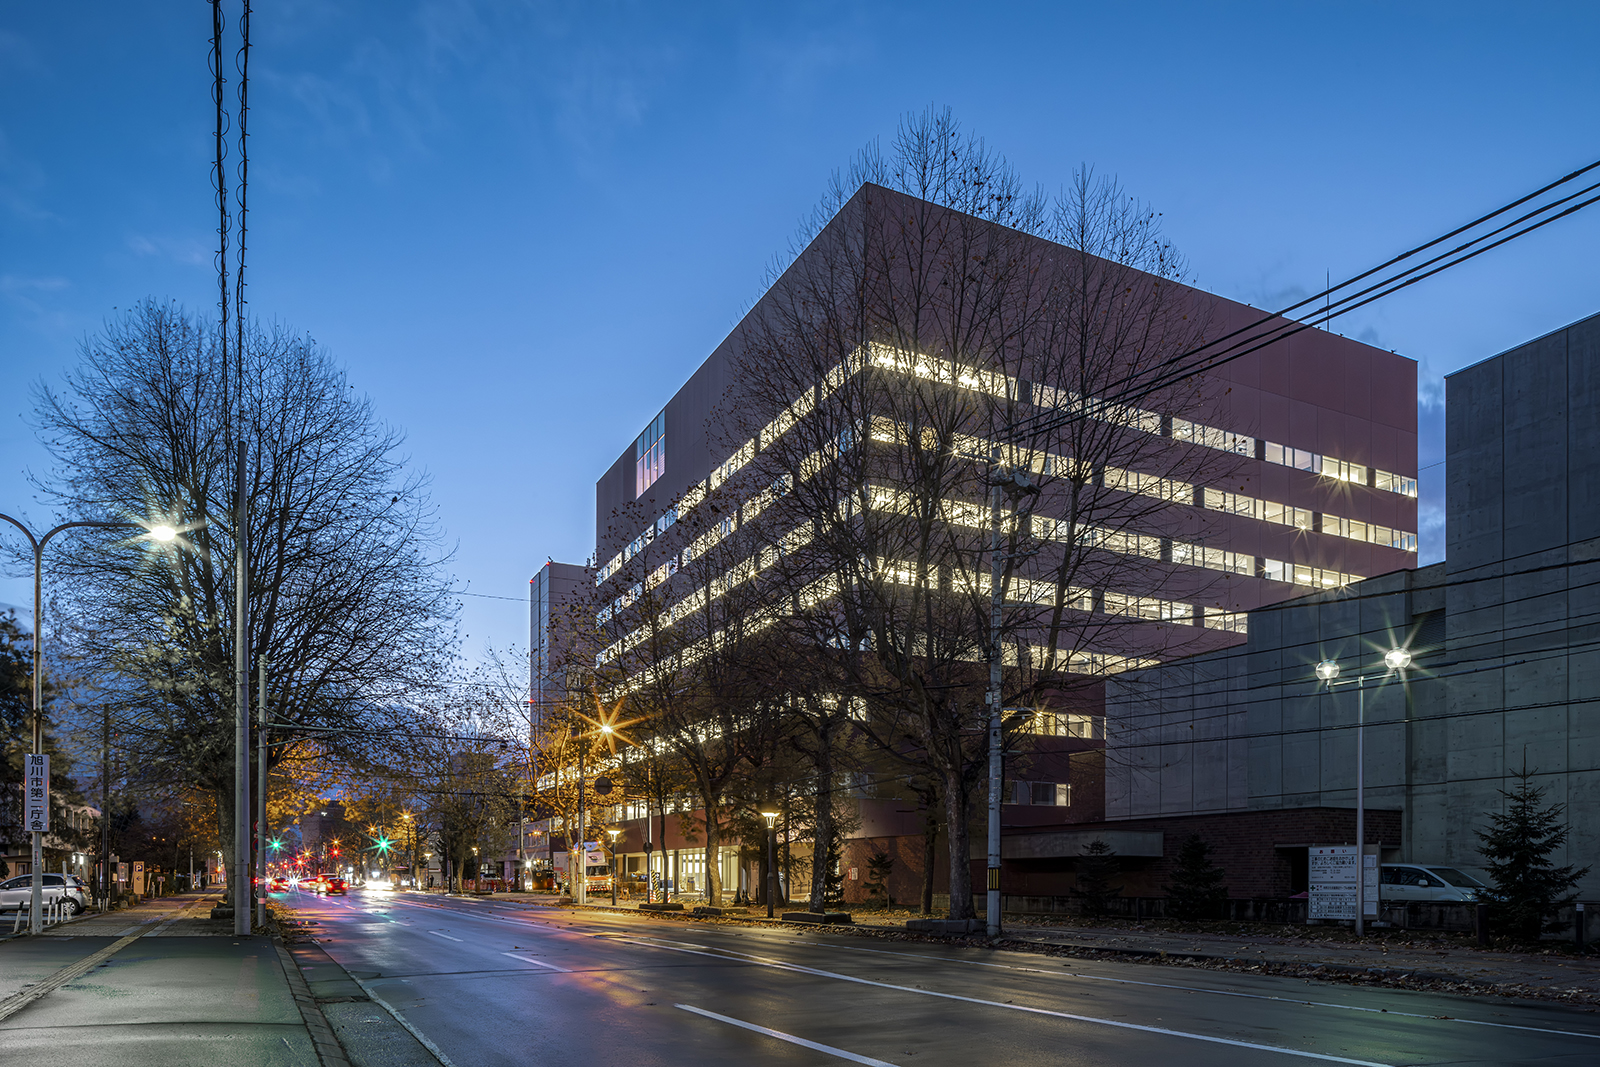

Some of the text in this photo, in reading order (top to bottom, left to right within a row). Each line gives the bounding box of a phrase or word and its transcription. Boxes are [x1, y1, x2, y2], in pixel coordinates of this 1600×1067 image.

[30, 755, 44, 831] 旭川市第二庁舎
